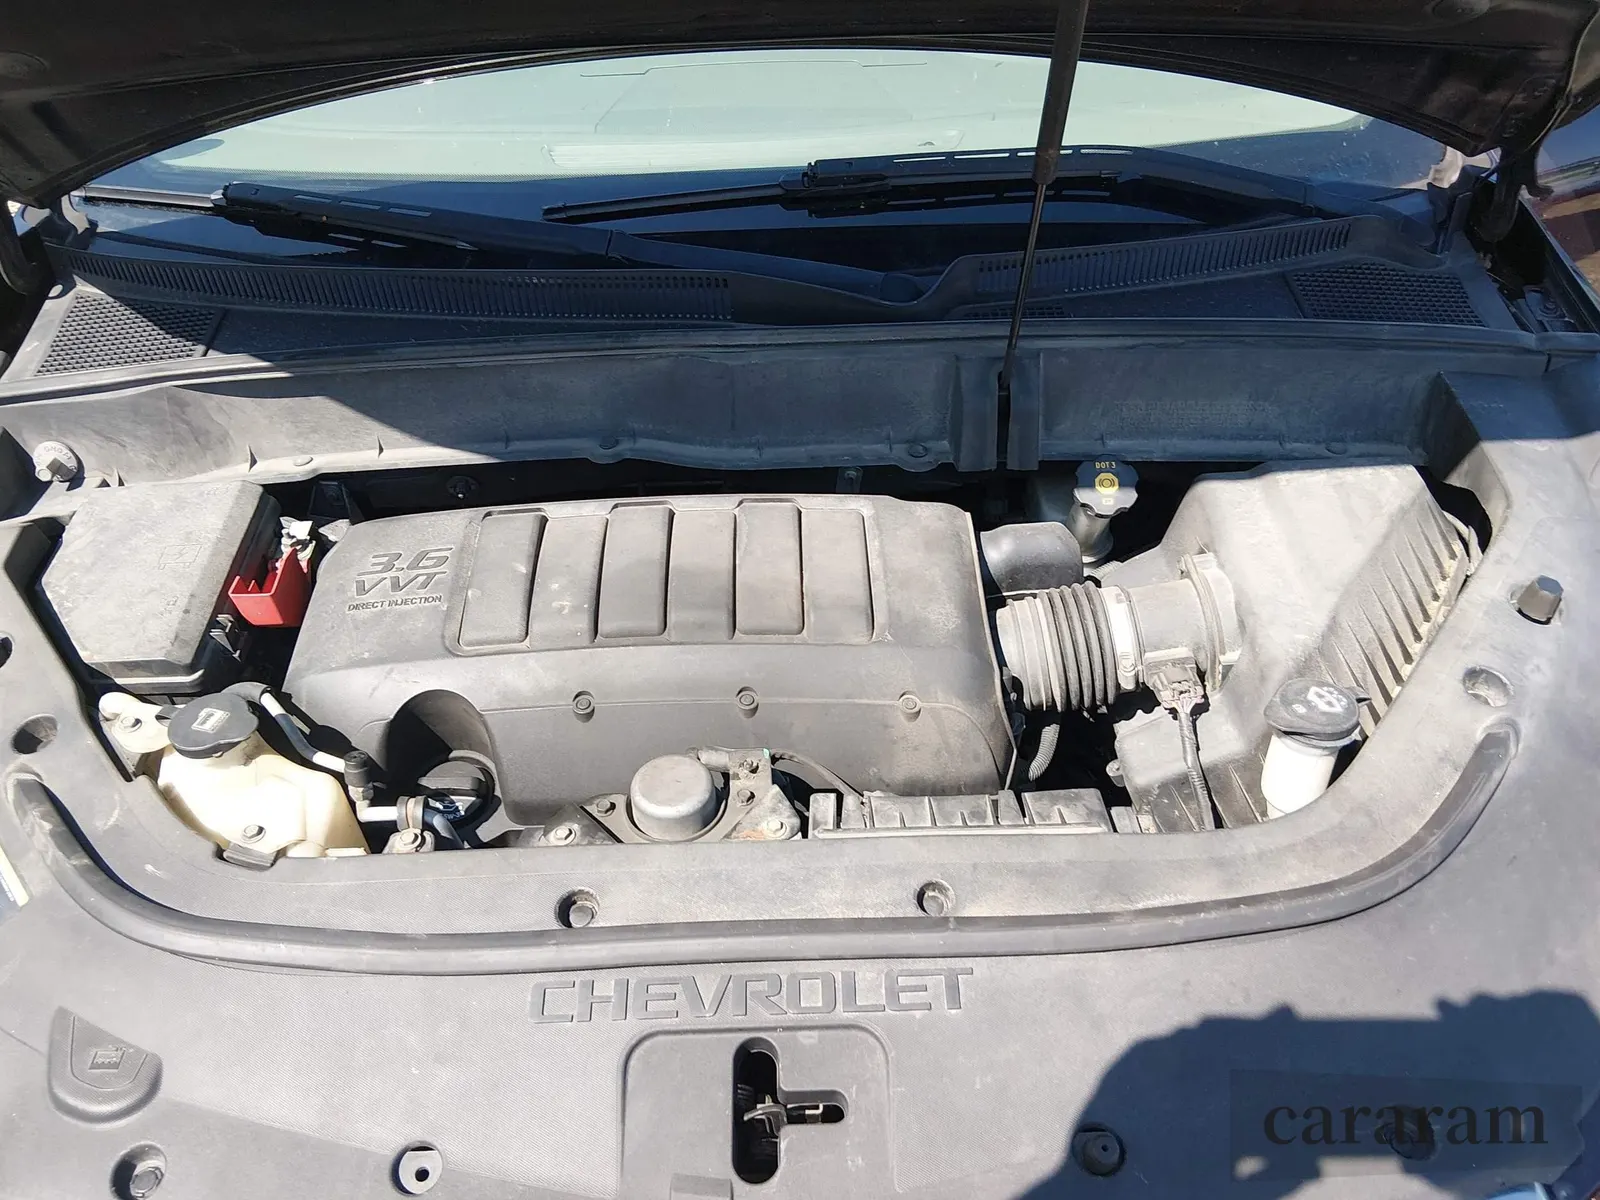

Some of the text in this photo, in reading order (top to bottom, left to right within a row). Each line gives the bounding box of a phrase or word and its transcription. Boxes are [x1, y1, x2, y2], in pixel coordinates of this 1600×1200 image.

[357, 547, 453, 576] 3.6
[355, 571, 447, 597] VVT
[347, 594, 443, 612] DIRECT INJECTION
[529, 966, 974, 1023] CHEVROLET
